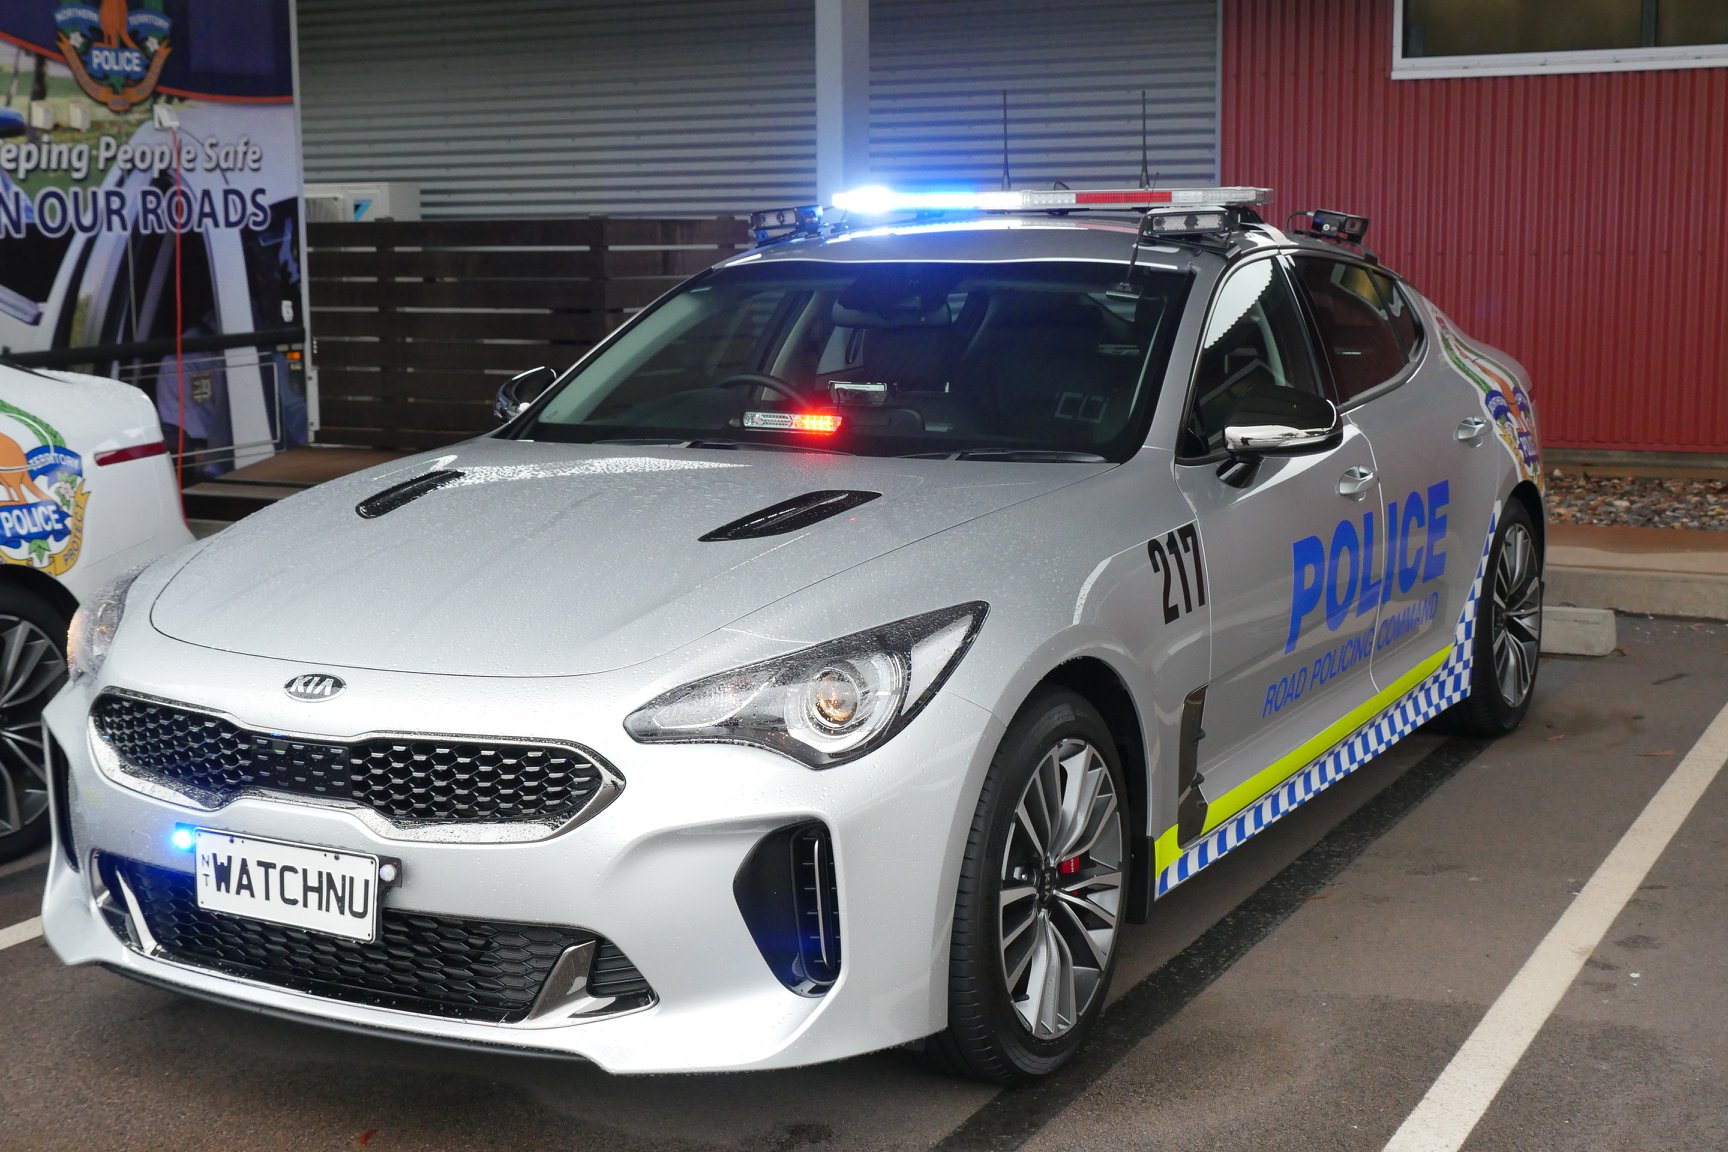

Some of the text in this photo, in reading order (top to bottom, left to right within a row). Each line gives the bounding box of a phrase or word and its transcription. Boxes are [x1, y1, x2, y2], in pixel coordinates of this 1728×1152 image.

[91, 49, 142, 72] POLICE
[98, 136, 196, 178] People
[202, 137, 262, 172] Safe
[37, 189, 128, 235] OUR
[141, 187, 269, 231] ROADS
[1, 504, 63, 537] POLICE
[1148, 521, 1205, 625] 217
[1285, 479, 1449, 655] POLICE
[1262, 592, 1439, 719] ROAD POLICING COMMAND
[290, 676, 334, 695] KIA
[212, 852, 369, 919] WATCHNU
